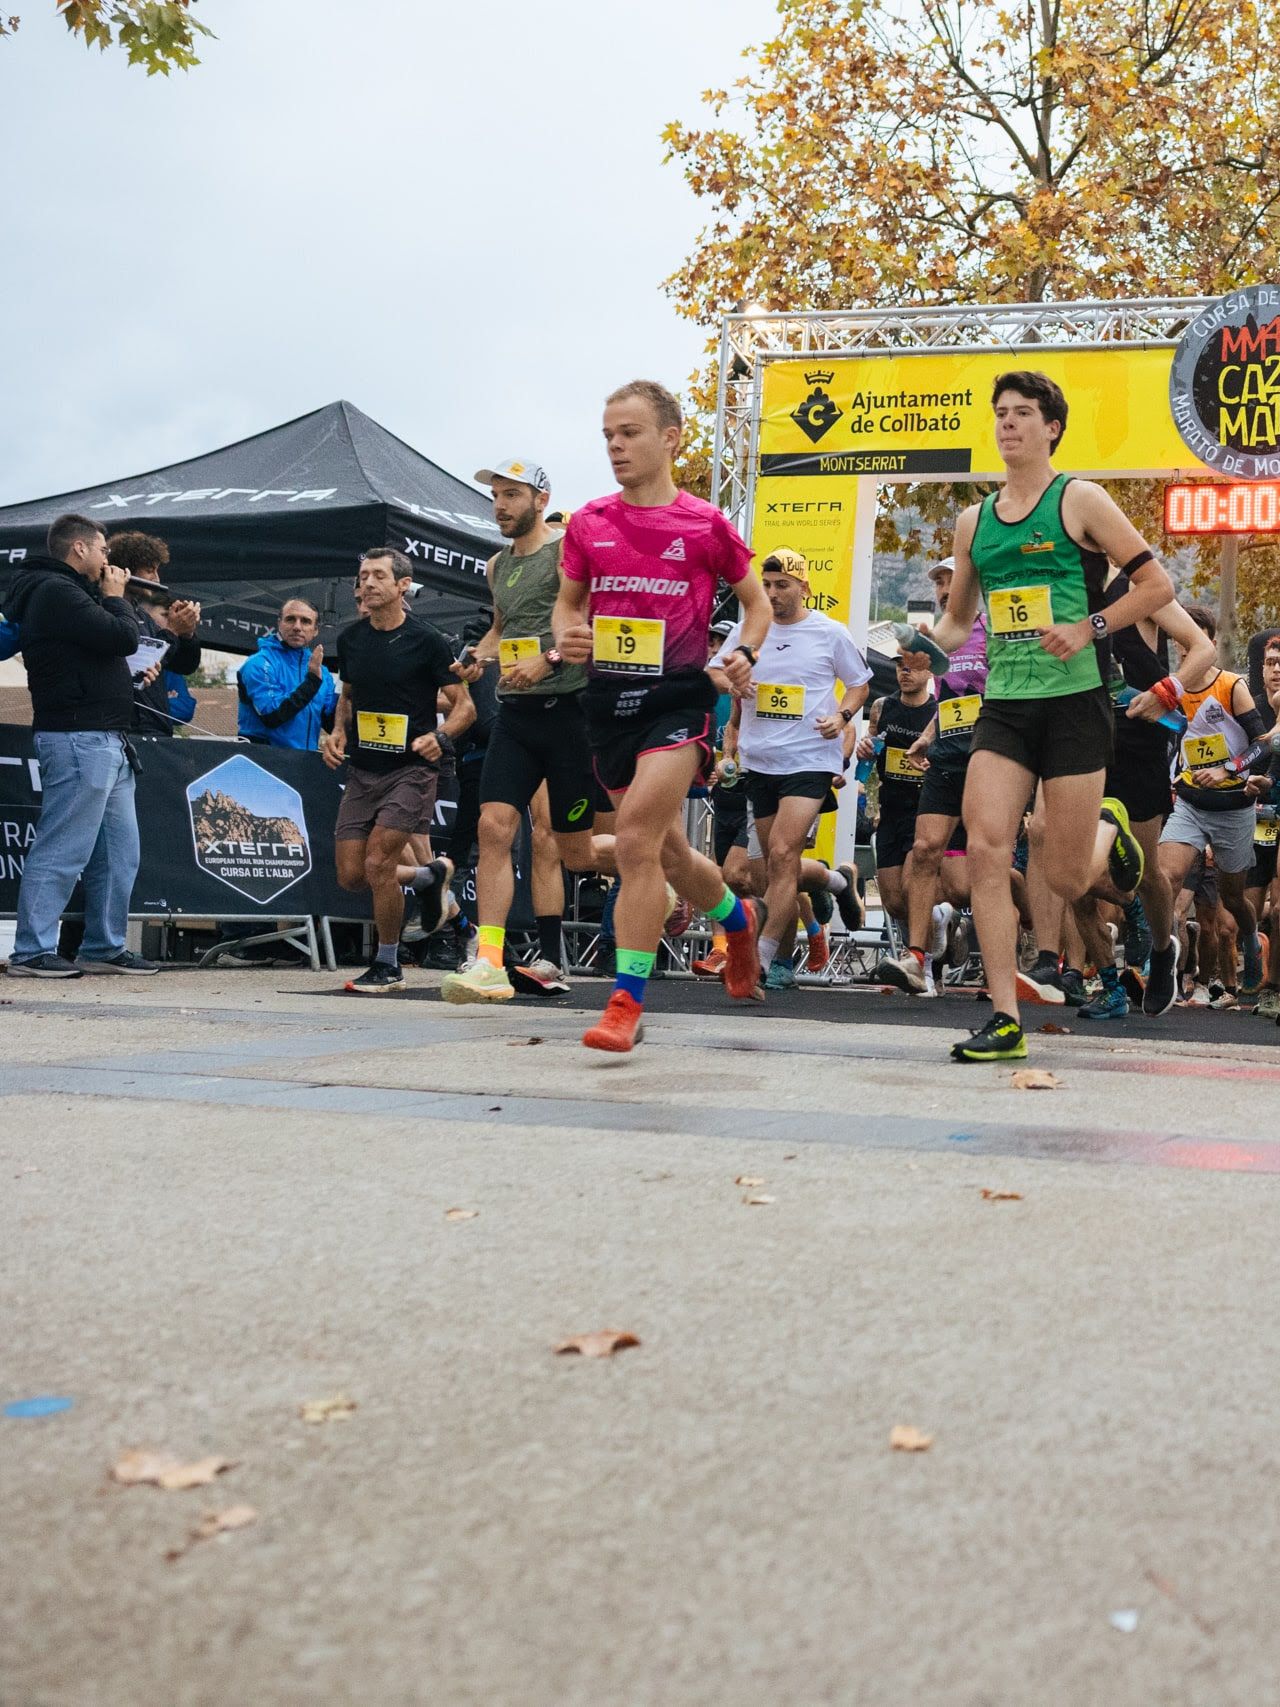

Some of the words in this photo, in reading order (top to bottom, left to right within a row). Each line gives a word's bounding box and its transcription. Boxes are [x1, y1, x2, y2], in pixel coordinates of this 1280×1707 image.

[1192, 294, 1250, 338] CURSA
[1258, 290, 1279, 306] DE
[851, 388, 973, 410] Ajuntament
[851, 416, 875, 434] de
[879, 412, 961, 434] Collbató
[1173, 393, 1218, 461] MARATÓ
[1222, 455, 1244, 474] DE
[820, 455, 907, 472] MONTSERRAT
[90, 487, 338, 509] XTERRA
[766, 502, 842, 513] XTERRA
[796, 519, 818, 527] WORLD
[404, 536, 489, 577] XTERRA
[1008, 605, 1028, 623] 16
[616, 636, 636, 654] 19
[770, 695, 788, 708] 96
[954, 710, 963, 722] 2
[378, 725, 386, 738] 3
[1197, 747, 1214, 759] 74
[899, 760, 913, 771] 52
[204, 840, 304, 857] XTERRA
[205, 857, 235, 865] EUROPEAN
[220, 867, 250, 877] CURSA
[253, 868, 264, 878] DE
[266, 868, 294, 878] L'ALBA
